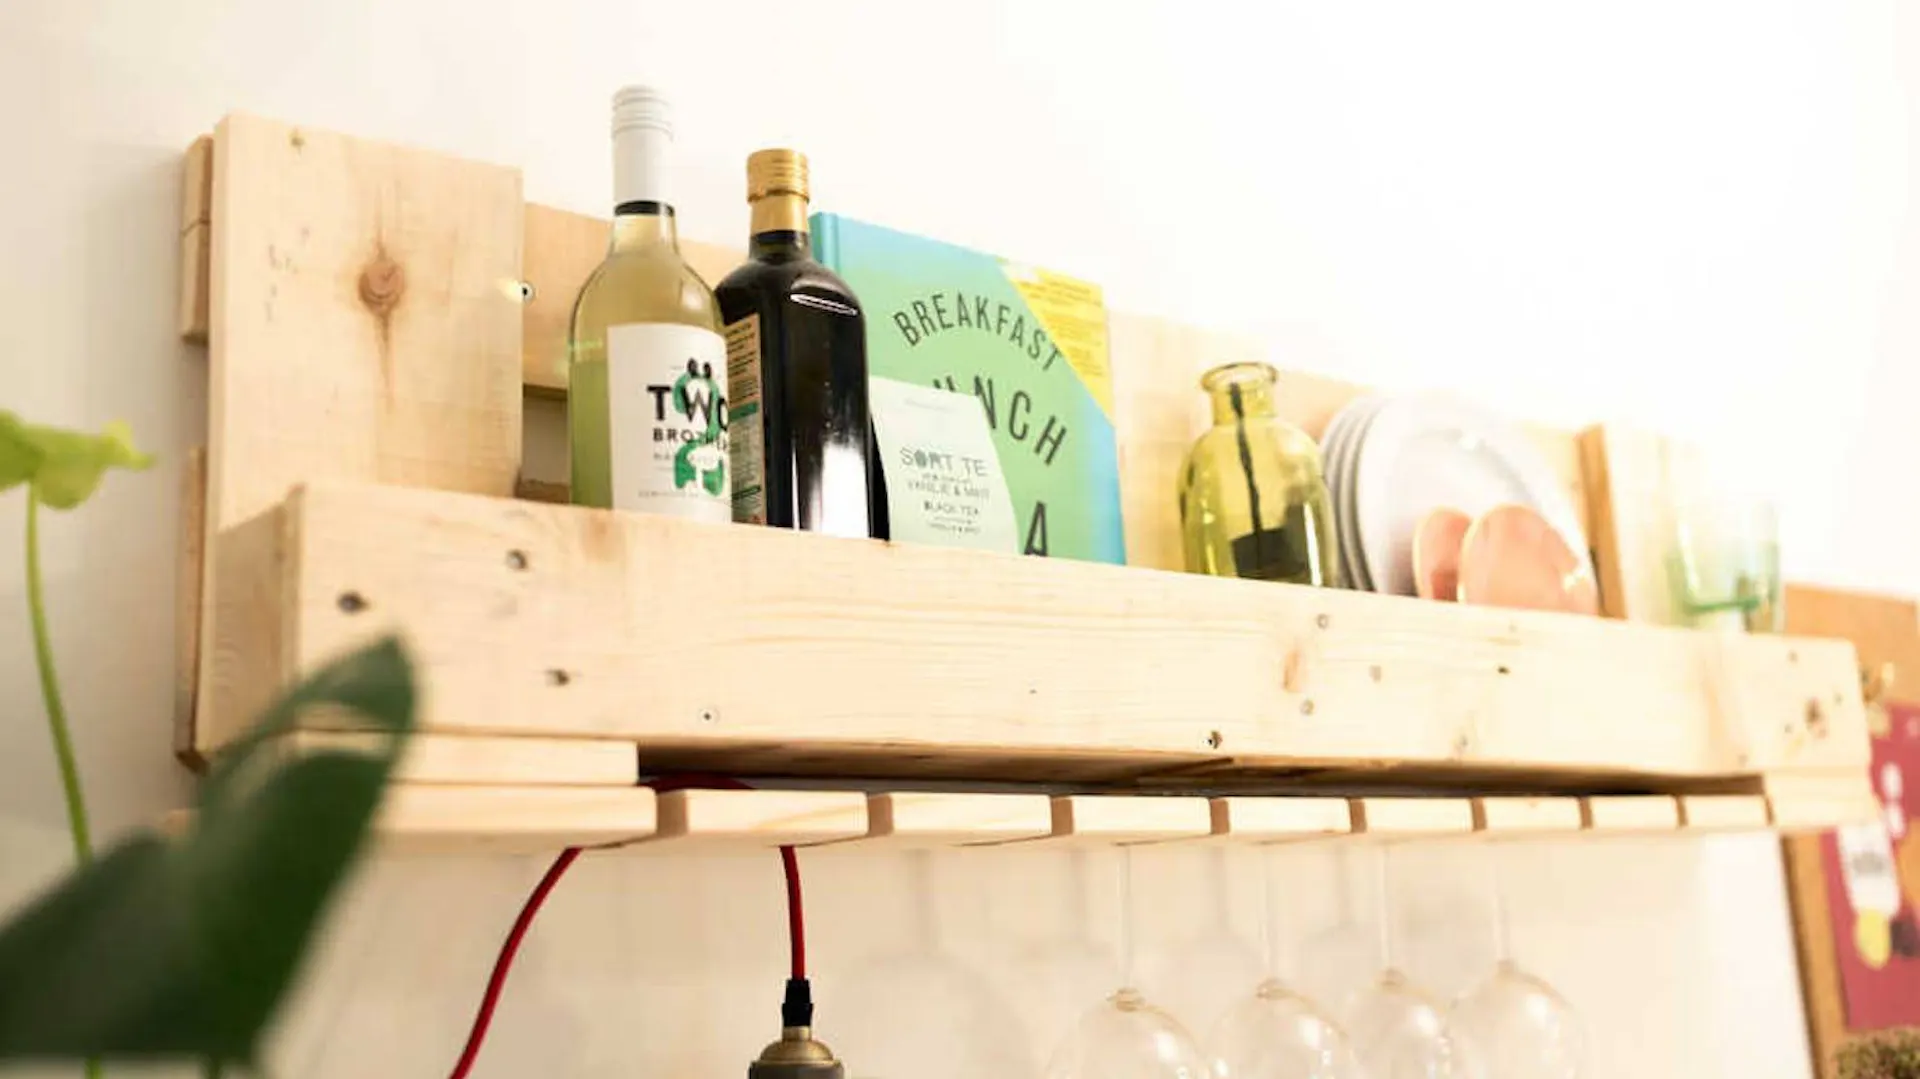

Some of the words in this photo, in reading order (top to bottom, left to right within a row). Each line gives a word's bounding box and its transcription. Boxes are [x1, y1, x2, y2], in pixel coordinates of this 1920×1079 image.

[894, 292, 1063, 370] BREAKFAST
[933, 374, 1067, 466] NCH
[960, 456, 989, 477] TE
